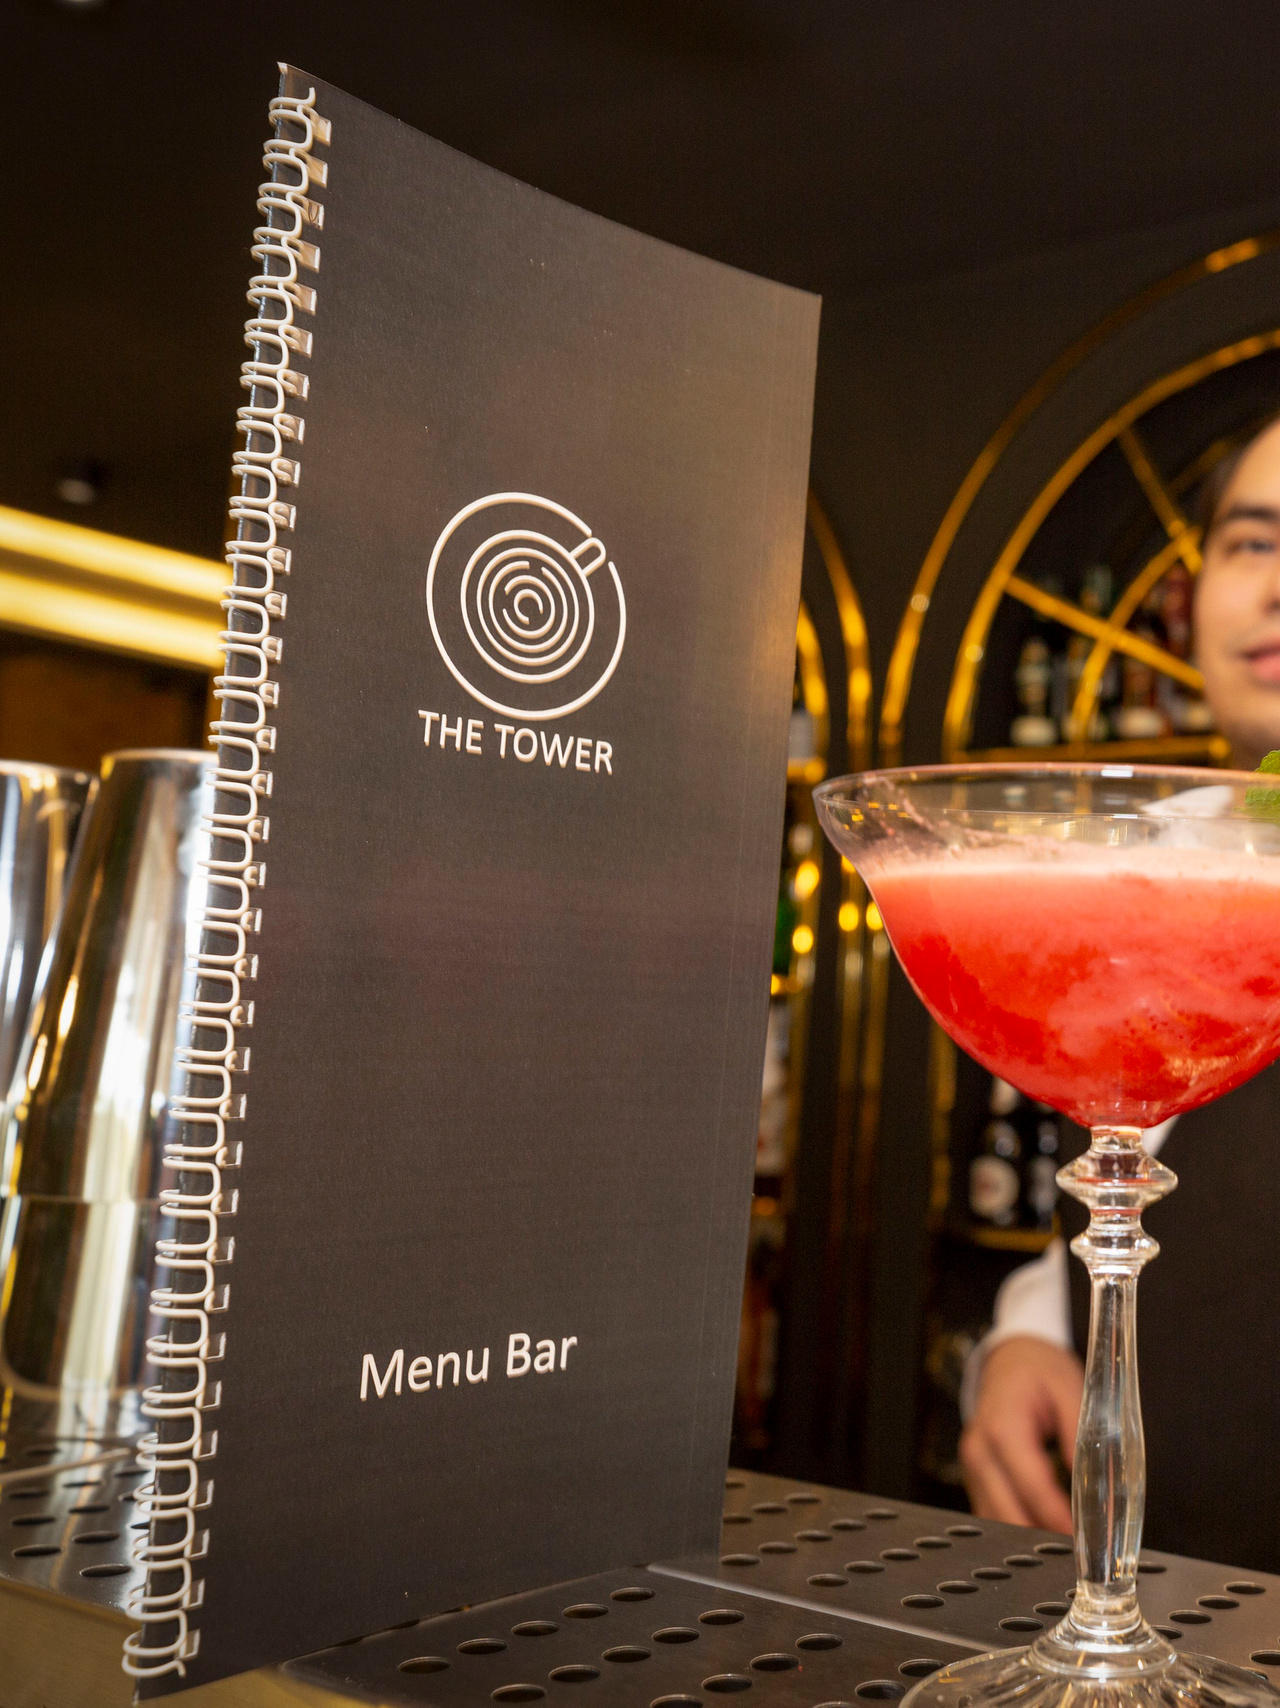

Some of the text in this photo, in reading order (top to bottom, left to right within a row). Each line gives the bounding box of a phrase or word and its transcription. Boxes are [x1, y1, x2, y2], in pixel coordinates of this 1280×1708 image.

[418, 709, 614, 776] THE TOWER
[360, 1332, 578, 1402] Menu Bar
